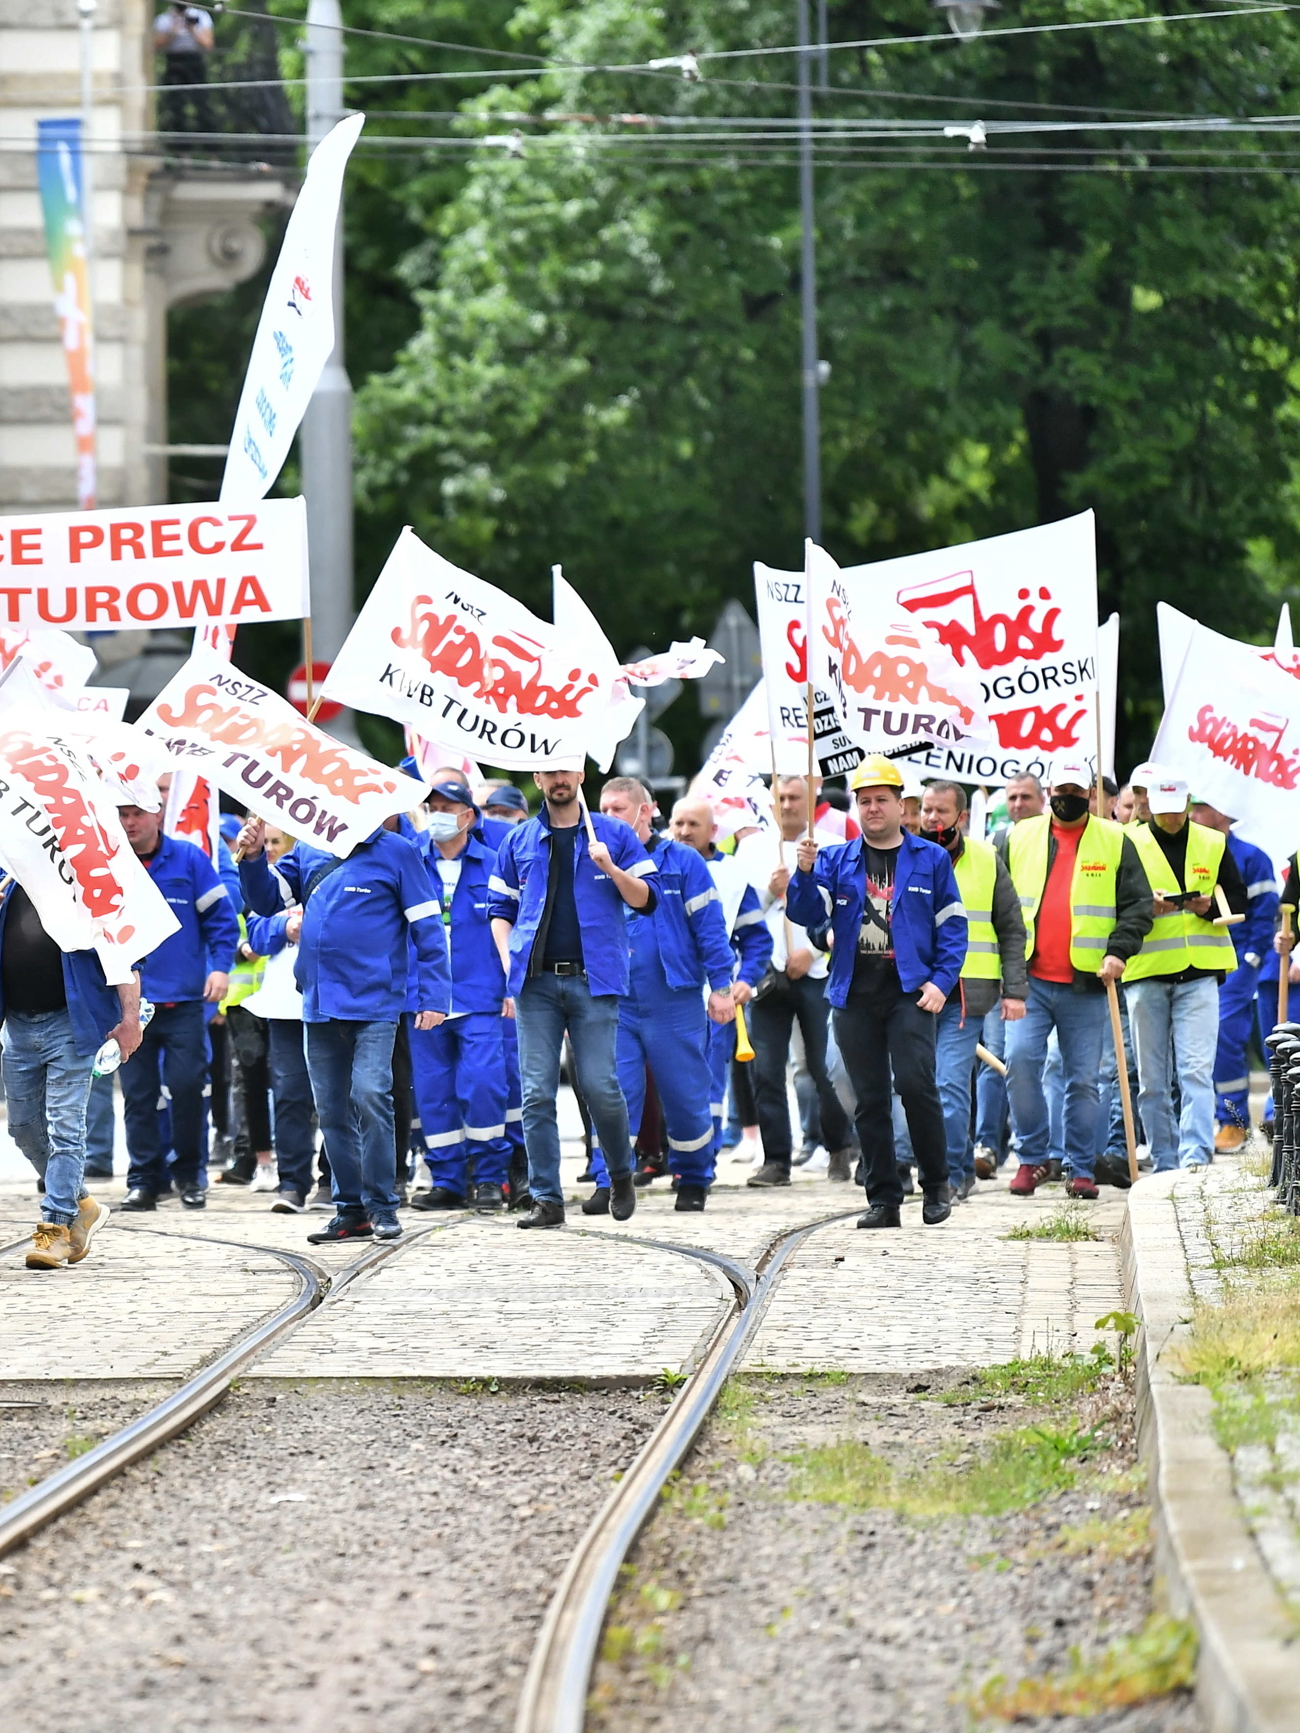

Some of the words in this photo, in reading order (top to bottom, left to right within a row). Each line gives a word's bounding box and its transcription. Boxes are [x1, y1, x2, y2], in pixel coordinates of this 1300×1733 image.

[68, 514, 264, 563] PRECZ
[766, 579, 806, 604] NSZZ
[208, 673, 269, 706] NSZZ
[441, 694, 563, 756] TURÓW
[827, 750, 861, 775] NAM
[221, 750, 349, 843] TURÓW
